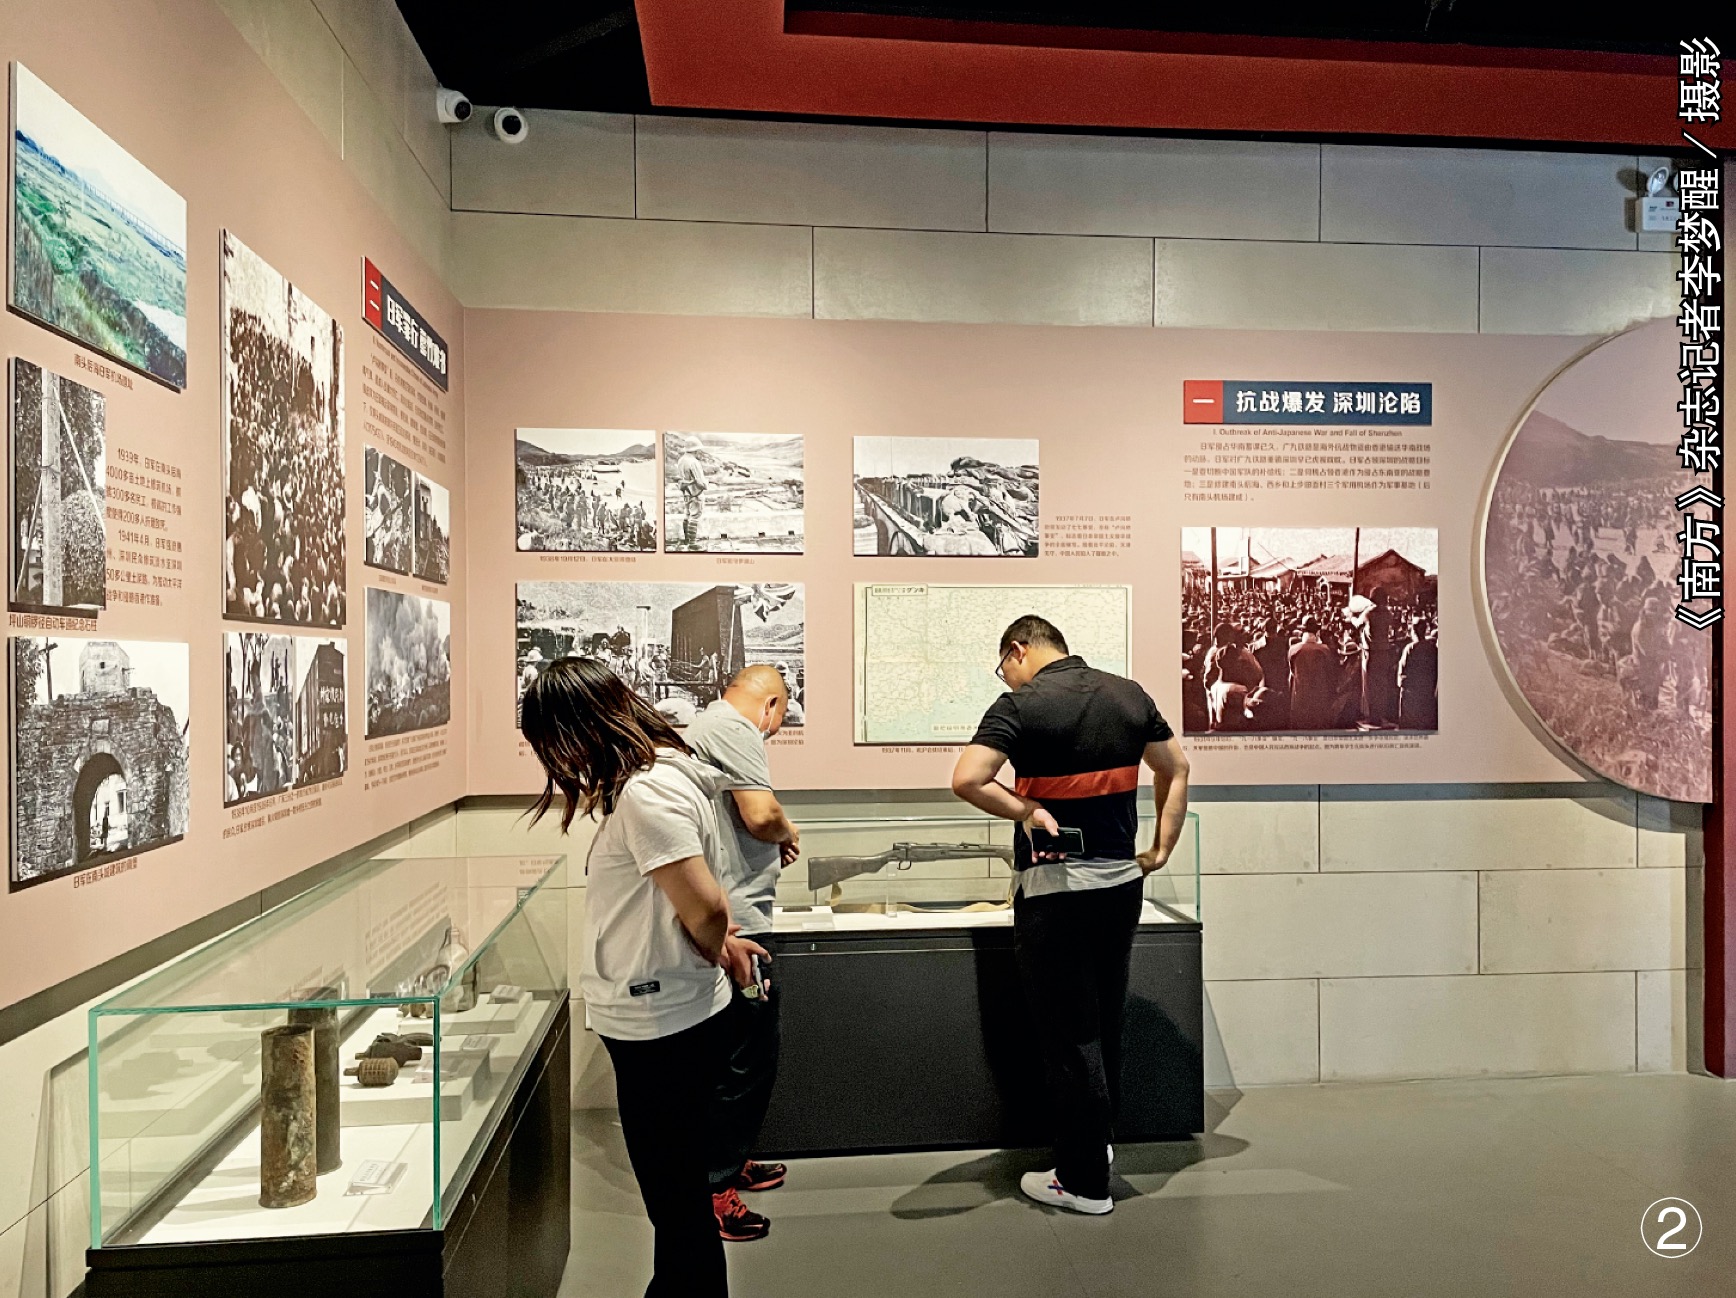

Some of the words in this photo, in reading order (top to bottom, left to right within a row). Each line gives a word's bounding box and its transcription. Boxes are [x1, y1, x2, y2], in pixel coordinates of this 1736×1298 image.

[370, 280, 380, 311] 二
[1192, 397, 1215, 405] 一
[1236, 390, 1326, 414] 抗战爆发
[1332, 391, 1421, 415] 深圳沦陷
[1219, 428, 1252, 436] Outbreak
[1253, 428, 1261, 436] of
[1262, 428, 1312, 437] Anti-Japanese
[1313, 428, 1328, 436] War
[1329, 429, 1343, 437] and
[1344, 429, 1358, 437] Fall
[1358, 429, 1367, 437] of
[1368, 429, 1403, 437] Shenzhen
